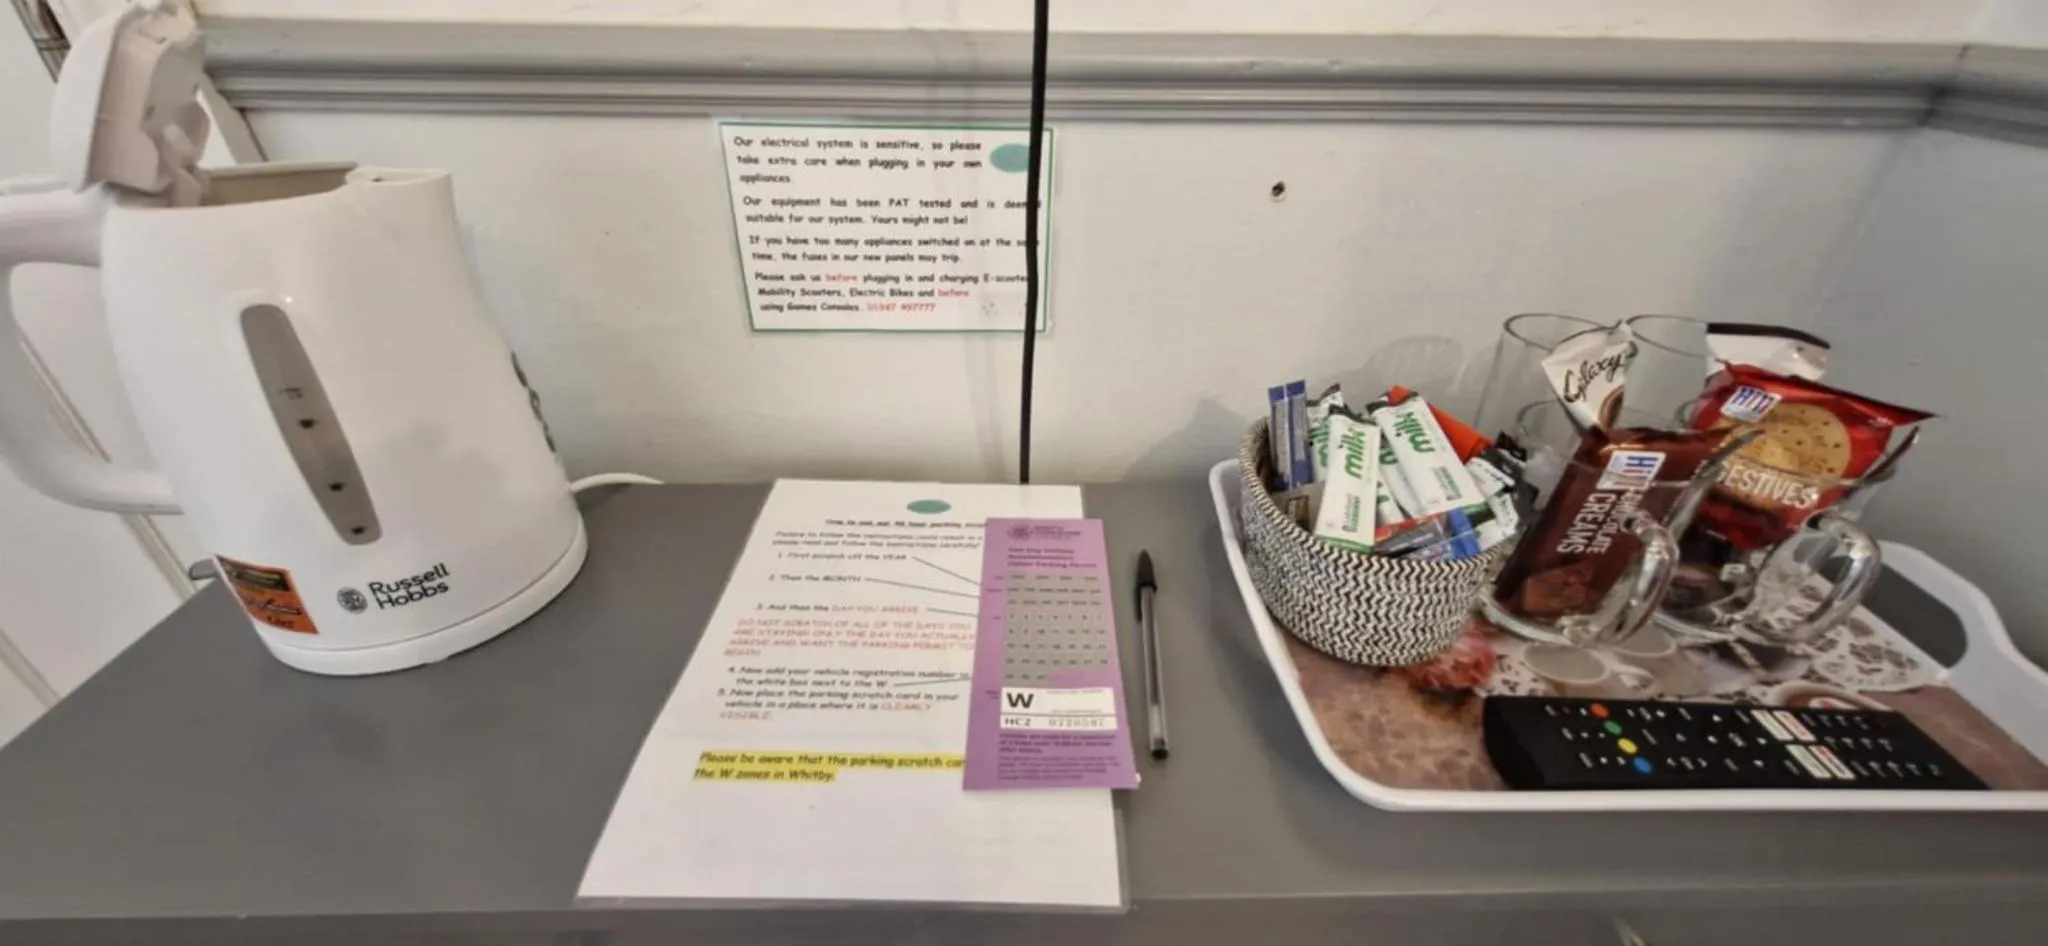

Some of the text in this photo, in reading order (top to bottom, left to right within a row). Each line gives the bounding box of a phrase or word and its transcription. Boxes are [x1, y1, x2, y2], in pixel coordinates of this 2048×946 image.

[734, 136, 753, 146] Our
[761, 137, 809, 147] electrical
[817, 139, 853, 150] system
[860, 139, 868, 148] is
[932, 142, 943, 150] so
[950, 140, 981, 152] please
[737, 155, 982, 169] take extra care when plugging in your own
[743, 196, 762, 206] Our
[771, 198, 820, 209] equipment
[830, 198, 847, 207] has
[856, 198, 880, 207] been
[888, 198, 909, 207] PAT
[919, 199, 952, 208] tested
[960, 199, 978, 208] and
[987, 199, 995, 208] is
[746, 213, 784, 223] suitable
[789, 213, 804, 223] for
[808, 215, 824, 223] our
[871, 215, 898, 224] Yours
[902, 215, 929, 226] might
[933, 216, 949, 224] not
[749, 235, 760, 244] If
[765, 237, 782, 246] you
[786, 236, 808, 245] have
[814, 236, 830, 245] too
[835, 238, 859, 247] many
[864, 237, 912, 247] appliances
[918, 237, 959, 246] switched
[980, 238, 990, 246] at
[996, 238, 1011, 246] the
[782, 252, 797, 260] the
[802, 252, 827, 261] fuses
[832, 252, 840, 260] in
[885, 253, 914, 262] panels
[918, 254, 937, 263] may
[755, 272, 784, 281] Please
[790, 272, 805, 281] ask
[825, 272, 857, 281] before
[863, 272, 899, 283] plugging
[905, 273, 913, 281] in
[918, 273, 934, 282] and
[940, 273, 978, 284] charging
[758, 287, 796, 297] Mobility
[849, 287, 885, 297] Electric
[890, 288, 913, 297] Bikes
[918, 288, 934, 297] and
[938, 288, 969, 297] before
[760, 303, 783, 313] using
[787, 302, 816, 311] Games
[1563, 350, 1628, 403] Galaxy
[1392, 411, 1436, 452] milk
[1338, 429, 1365, 479] milk
[1556, 492, 1617, 553] CREAMS
[368, 562, 450, 596] Russell
[376, 582, 449, 610] Hobbs
[1006, 692, 1034, 708] W
[700, 752, 737, 764] Please
[740, 753, 755, 763] be
[758, 755, 793, 764] aware
[798, 754, 822, 764] that
[827, 754, 847, 765] the
[849, 755, 895, 768] parking
[897, 755, 943, 767] scratch
[694, 768, 715, 778] the
[719, 768, 734, 778] W
[735, 769, 770, 779] zones
[773, 769, 784, 778] in
